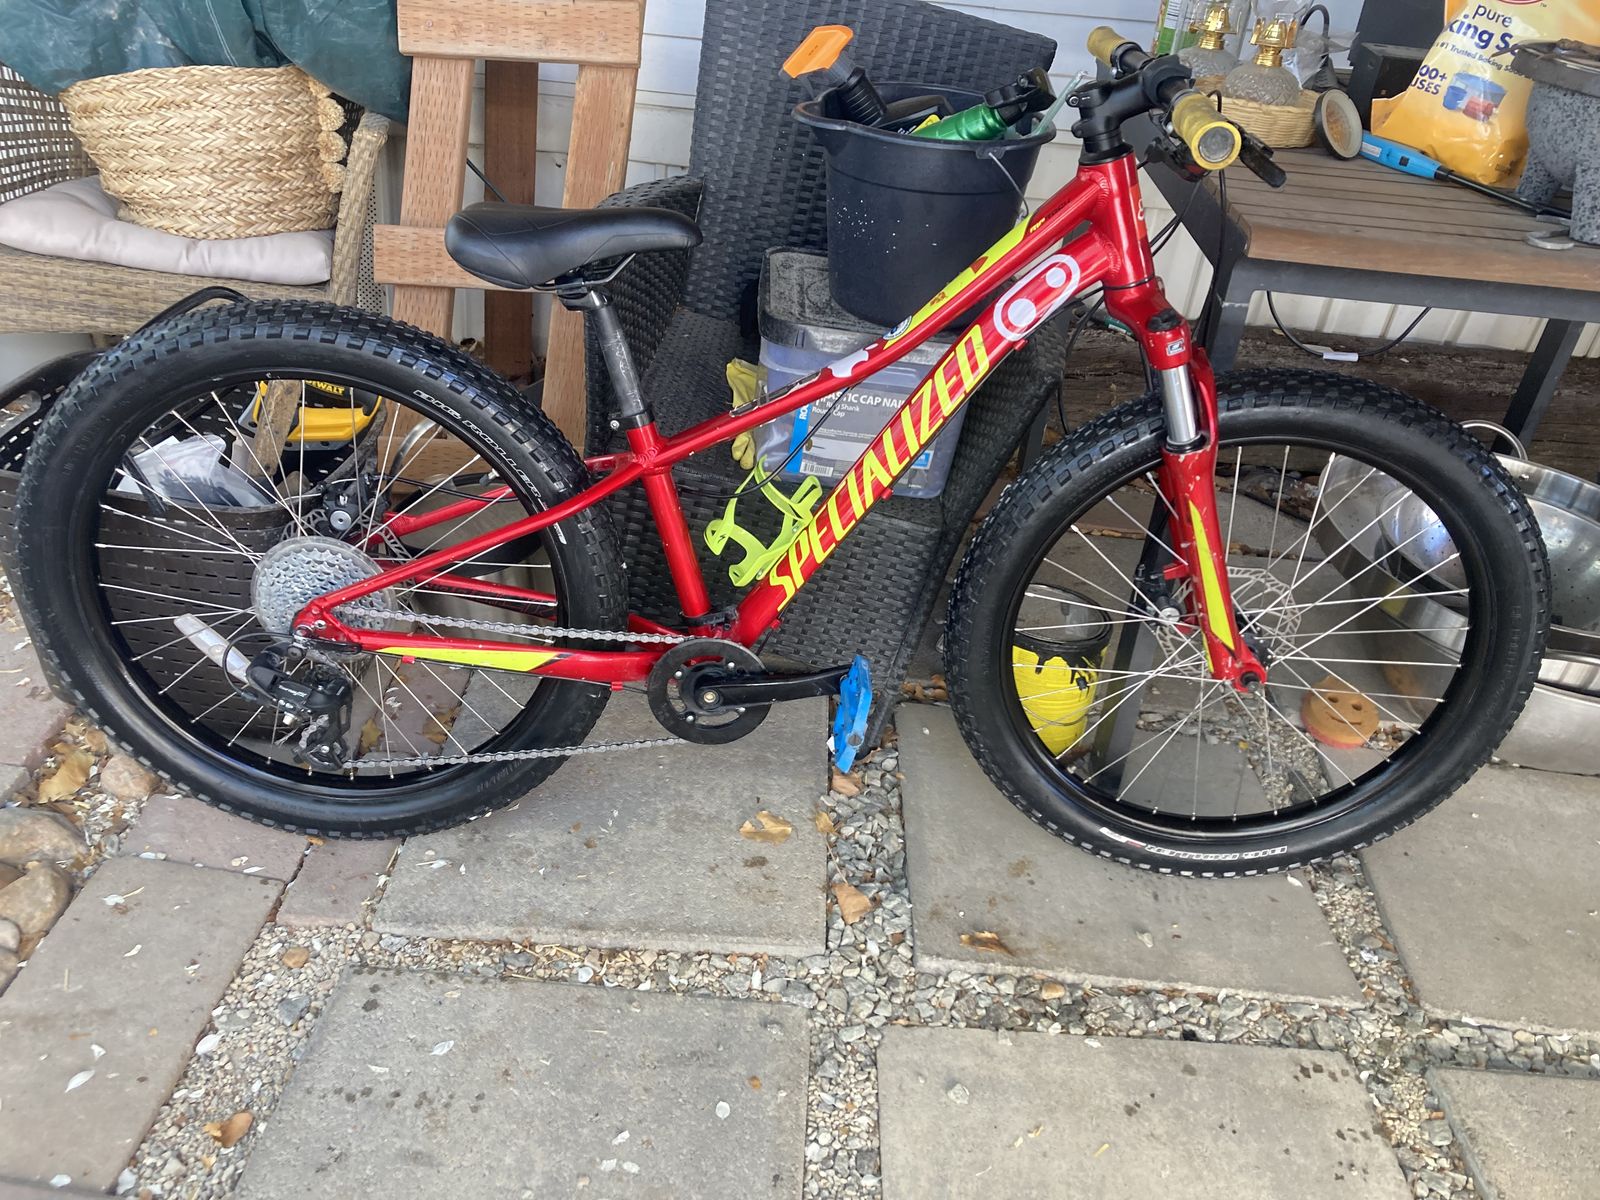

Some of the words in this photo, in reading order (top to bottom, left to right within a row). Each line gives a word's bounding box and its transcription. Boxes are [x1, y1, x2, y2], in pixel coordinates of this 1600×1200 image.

[1472, 4, 1513, 28] pure
[1450, 44, 1478, 60] Trusted
[860, 394, 882, 405] CAP
[833, 409, 846, 418] Cap
[841, 403, 860, 412] Shank
[768, 323, 990, 612] SPECIALIZED
